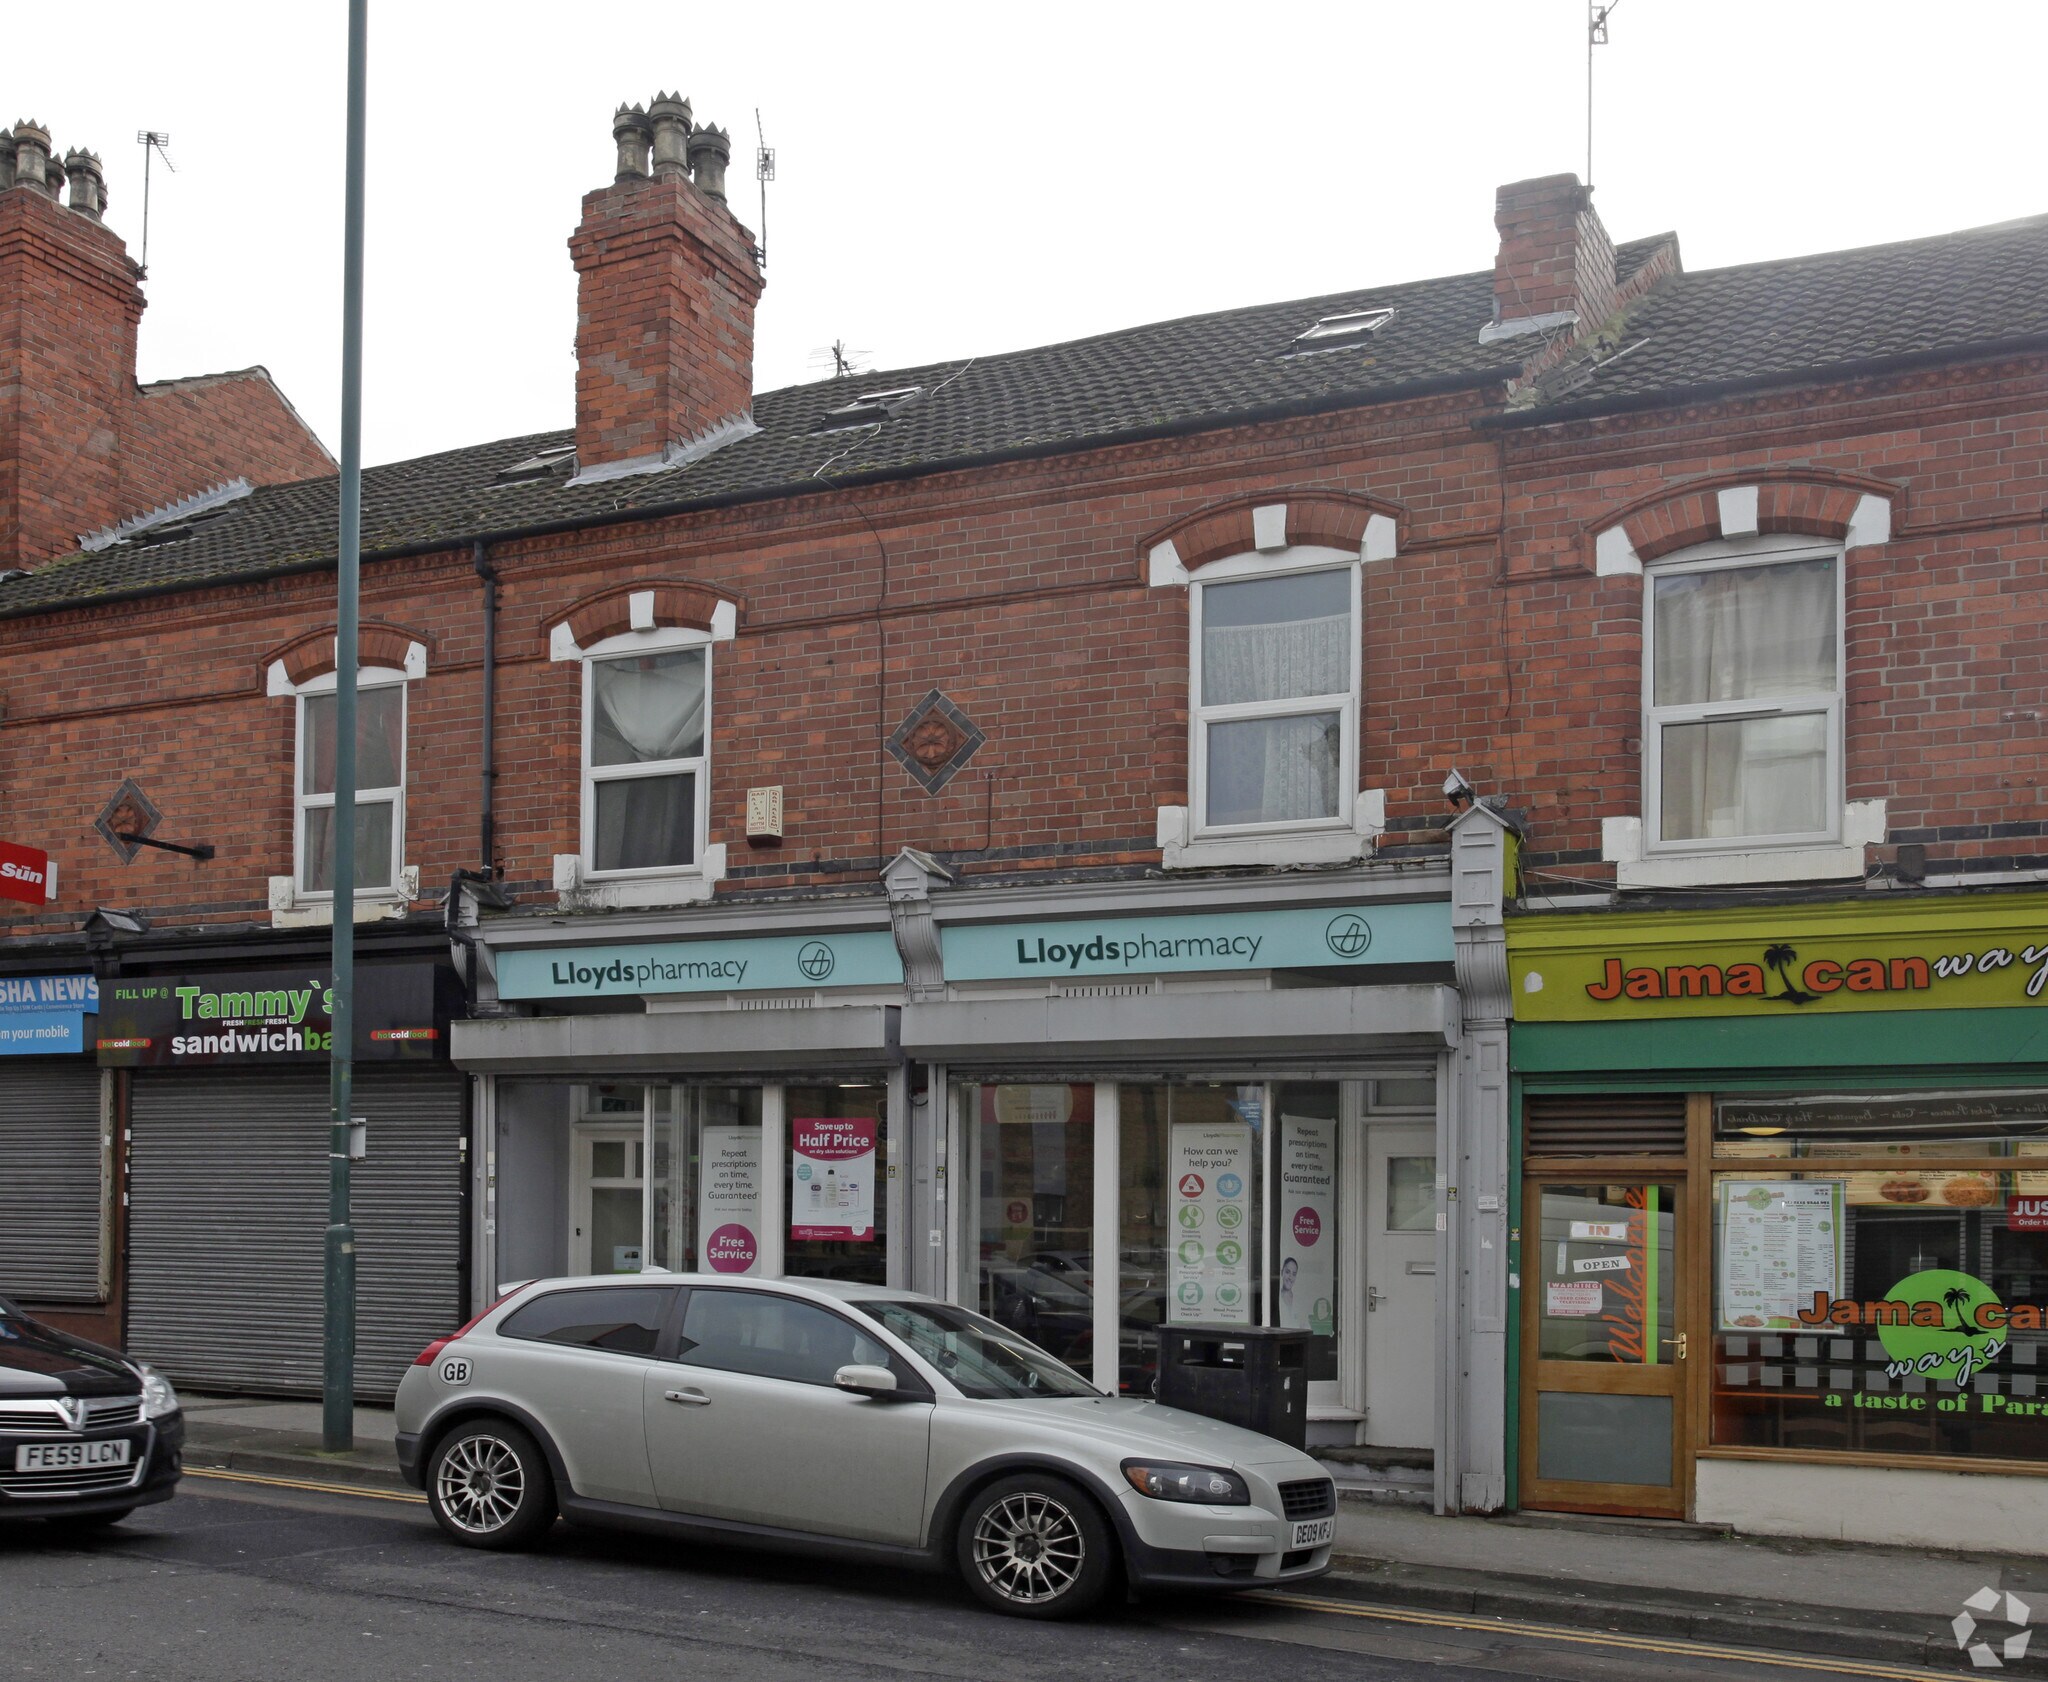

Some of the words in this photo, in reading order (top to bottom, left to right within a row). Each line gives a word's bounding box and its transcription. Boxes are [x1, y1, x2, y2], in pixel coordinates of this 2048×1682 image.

[0, 862, 43, 885] Sun
[1016, 932, 1263, 969] Lloydspharmacy
[551, 957, 748, 989] Lloydspharmacy
[40, 976, 99, 1001] NEWS
[115, 989, 139, 999] FILL
[142, 988, 158, 999] UP
[11, 1029, 34, 1042] your
[35, 1024, 70, 1038] mobile
[814, 1122, 833, 1131] Save
[833, 1124, 844, 1132] up
[844, 1123, 854, 1131] to
[1296, 1126, 1319, 1137] Repeat
[799, 1133, 831, 1147] Half
[833, 1133, 870, 1147] Price
[1288, 1139, 1327, 1149] prescriptions
[721, 1149, 747, 1159] Repeat
[1183, 1147, 1204, 1156] How
[1205, 1148, 1223, 1156] can
[1224, 1148, 1239, 1156] we
[711, 1160, 757, 1170] prescriptions
[1188, 1158, 1209, 1169] help
[1211, 1158, 1232, 1169] you?
[1291, 1162, 1308, 1172] every
[730, 1170, 749, 1179] time,
[713, 1181, 734, 1191] every
[735, 1180, 754, 1189] time.
[1299, 1216, 1315, 1226] Free
[2018, 1218, 2042, 1226] Order
[1294, 1224, 1319, 1235] Service
[1588, 1225, 1610, 1236] IN
[719, 1235, 745, 1248] Free
[709, 1247, 753, 1260] Service
[1582, 1259, 1621, 1271] OPEN
[1602, 1186, 1648, 1363] Welcome
[1884, 1337, 2008, 1387] ways
[443, 1362, 468, 1382] GB
[1824, 1392, 1843, 1408] a
[1853, 1390, 1927, 1411] taste
[1936, 1392, 1969, 1413] of
[27, 1445, 83, 1467] FE59
